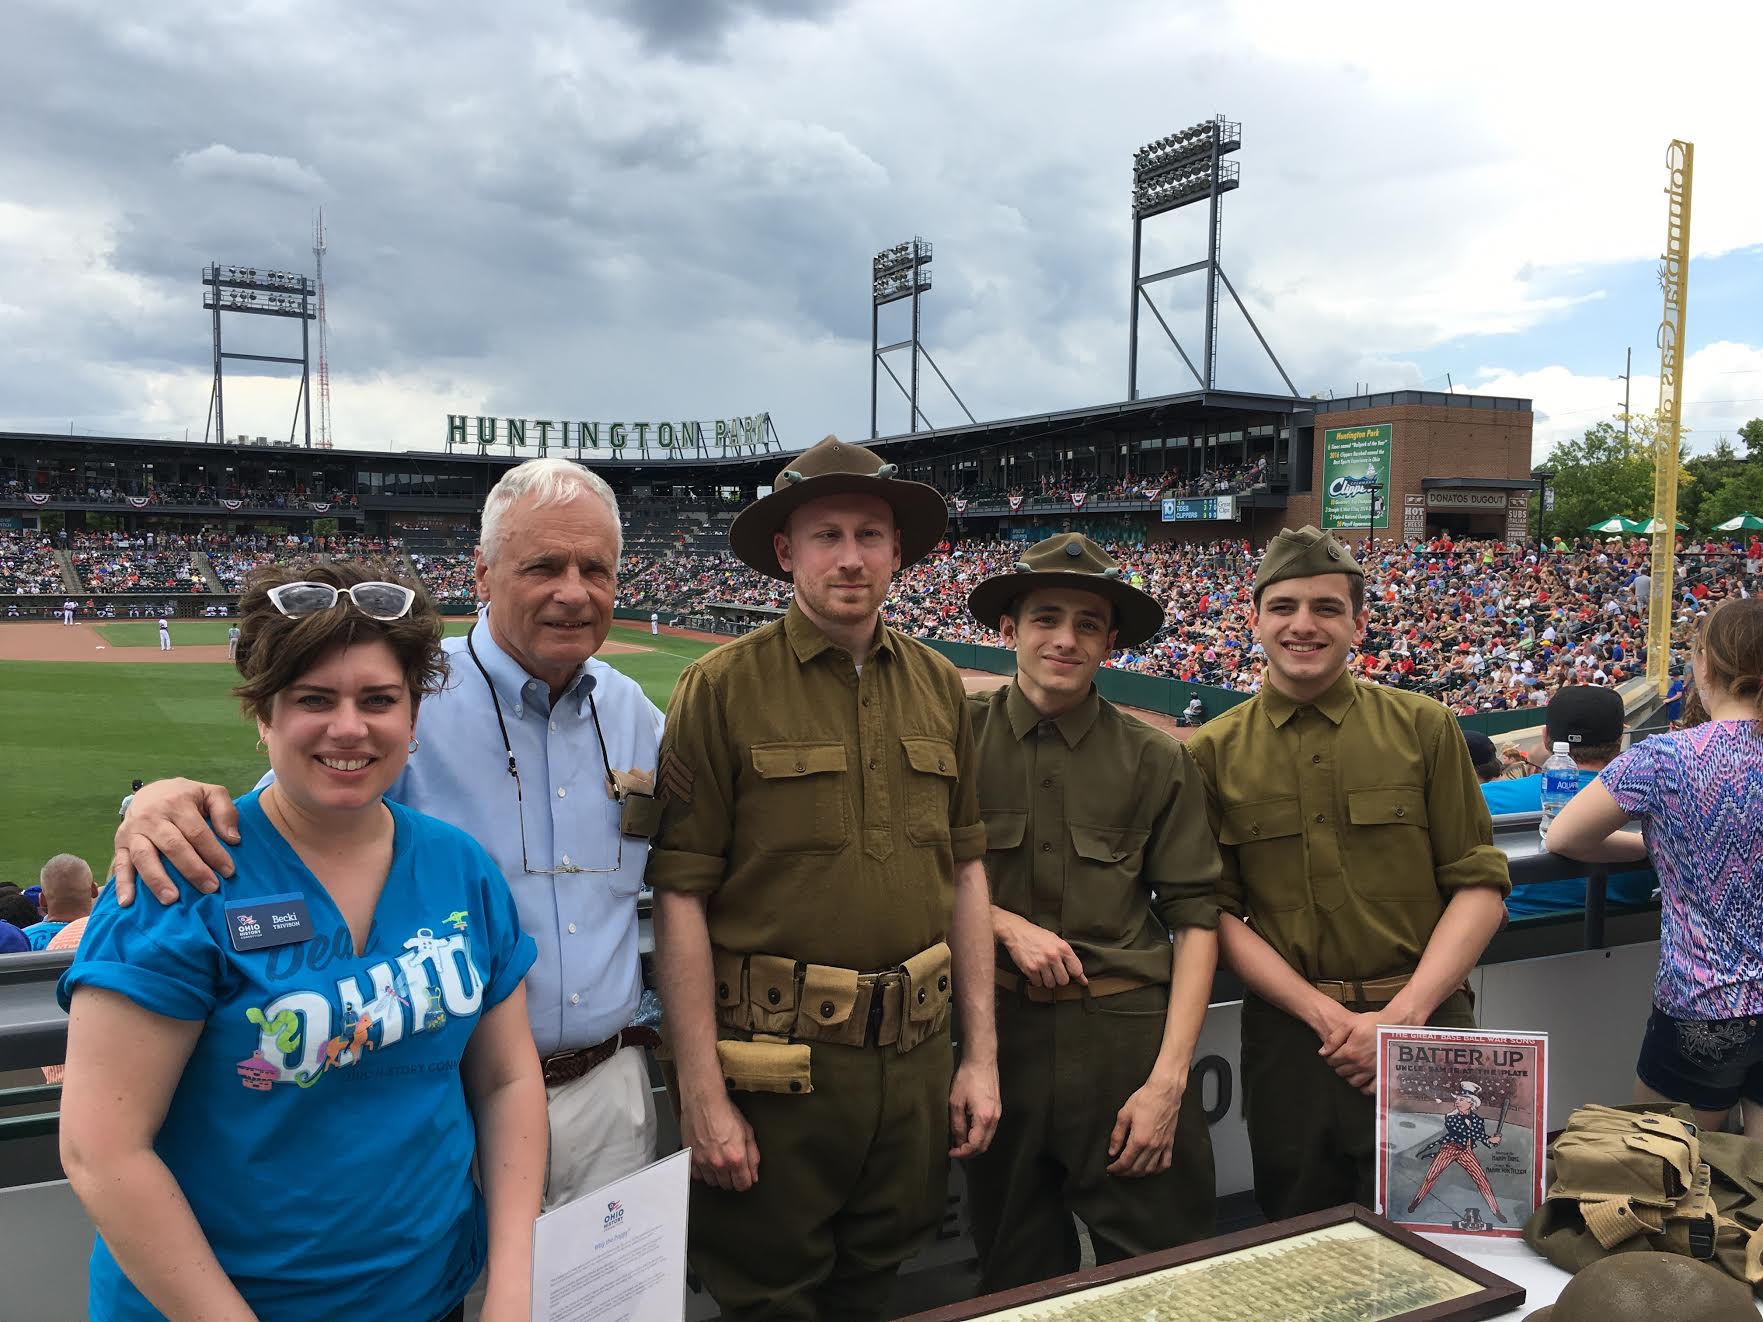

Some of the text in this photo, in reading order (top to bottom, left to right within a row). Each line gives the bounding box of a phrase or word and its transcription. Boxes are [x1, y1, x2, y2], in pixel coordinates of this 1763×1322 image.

[447, 413, 768, 449] HUNTINGTON PARK
[1336, 429, 1380, 440] Huntington Park
[1430, 493, 1504, 504] DONATOS DUGOUT
[1163, 502, 1174, 515] 10
[1405, 507, 1424, 515] HOT
[1508, 510, 1526, 518] SUBS
[272, 912, 297, 923] Becki
[238, 924, 260, 932] OHIO
[273, 921, 300, 930] TRIVISON
[259, 934, 483, 1085] OHIO
[1397, 1045, 1524, 1067] BATTER UP
[1501, 1069, 1529, 1077] PLATE
[604, 1208, 624, 1223] OHIO
[604, 1216, 623, 1228] HISTORY
